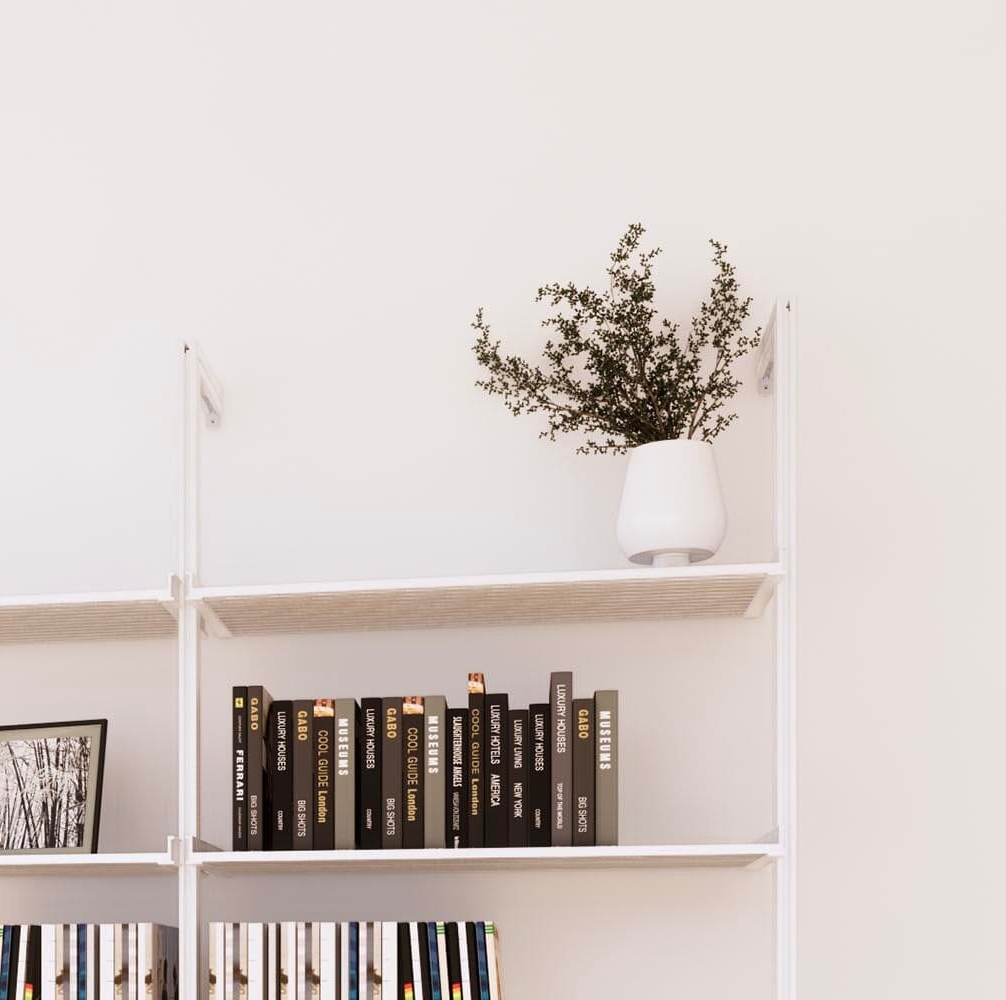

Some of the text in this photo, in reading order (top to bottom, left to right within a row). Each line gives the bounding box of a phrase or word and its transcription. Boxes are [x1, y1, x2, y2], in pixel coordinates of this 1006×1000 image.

[250, 698, 258, 730] GABO
[298, 710, 308, 740] GABO
[366, 708, 375, 769] LUXURY HOUSES
[386, 708, 396, 738] GABO
[490, 705, 500, 764] LUXURY HOTELS
[556, 684, 566, 753] LUXURY HOUSES
[578, 709, 588, 739] GABO
[277, 712, 286, 771] LUXURY HOUSES
[338, 718, 348, 776] MUSEUMS
[428, 716, 438, 774] MUSEUMS
[452, 716, 462, 765] SLAUGHTERHOUSE
[471, 708, 480, 816] COOL GUIDE London
[514, 720, 522, 768] LUXURY LIVING
[534, 714, 544, 771] LUXURY HOUSES
[600, 710, 611, 770] MUSEUMS
[236, 750, 244, 800] FERRARI
[318, 730, 328, 823] COOL GUIDE London
[408, 728, 418, 822] COOL GUIDE London
[452, 766, 462, 788] ANGELS
[490, 774, 500, 807] AMERICA
[298, 800, 306, 837] BIG SHOTS
[386, 798, 395, 836] BIG SHOTS
[514, 782, 522, 818] NEW YORK
[578, 796, 587, 832] BIG SHOTS
